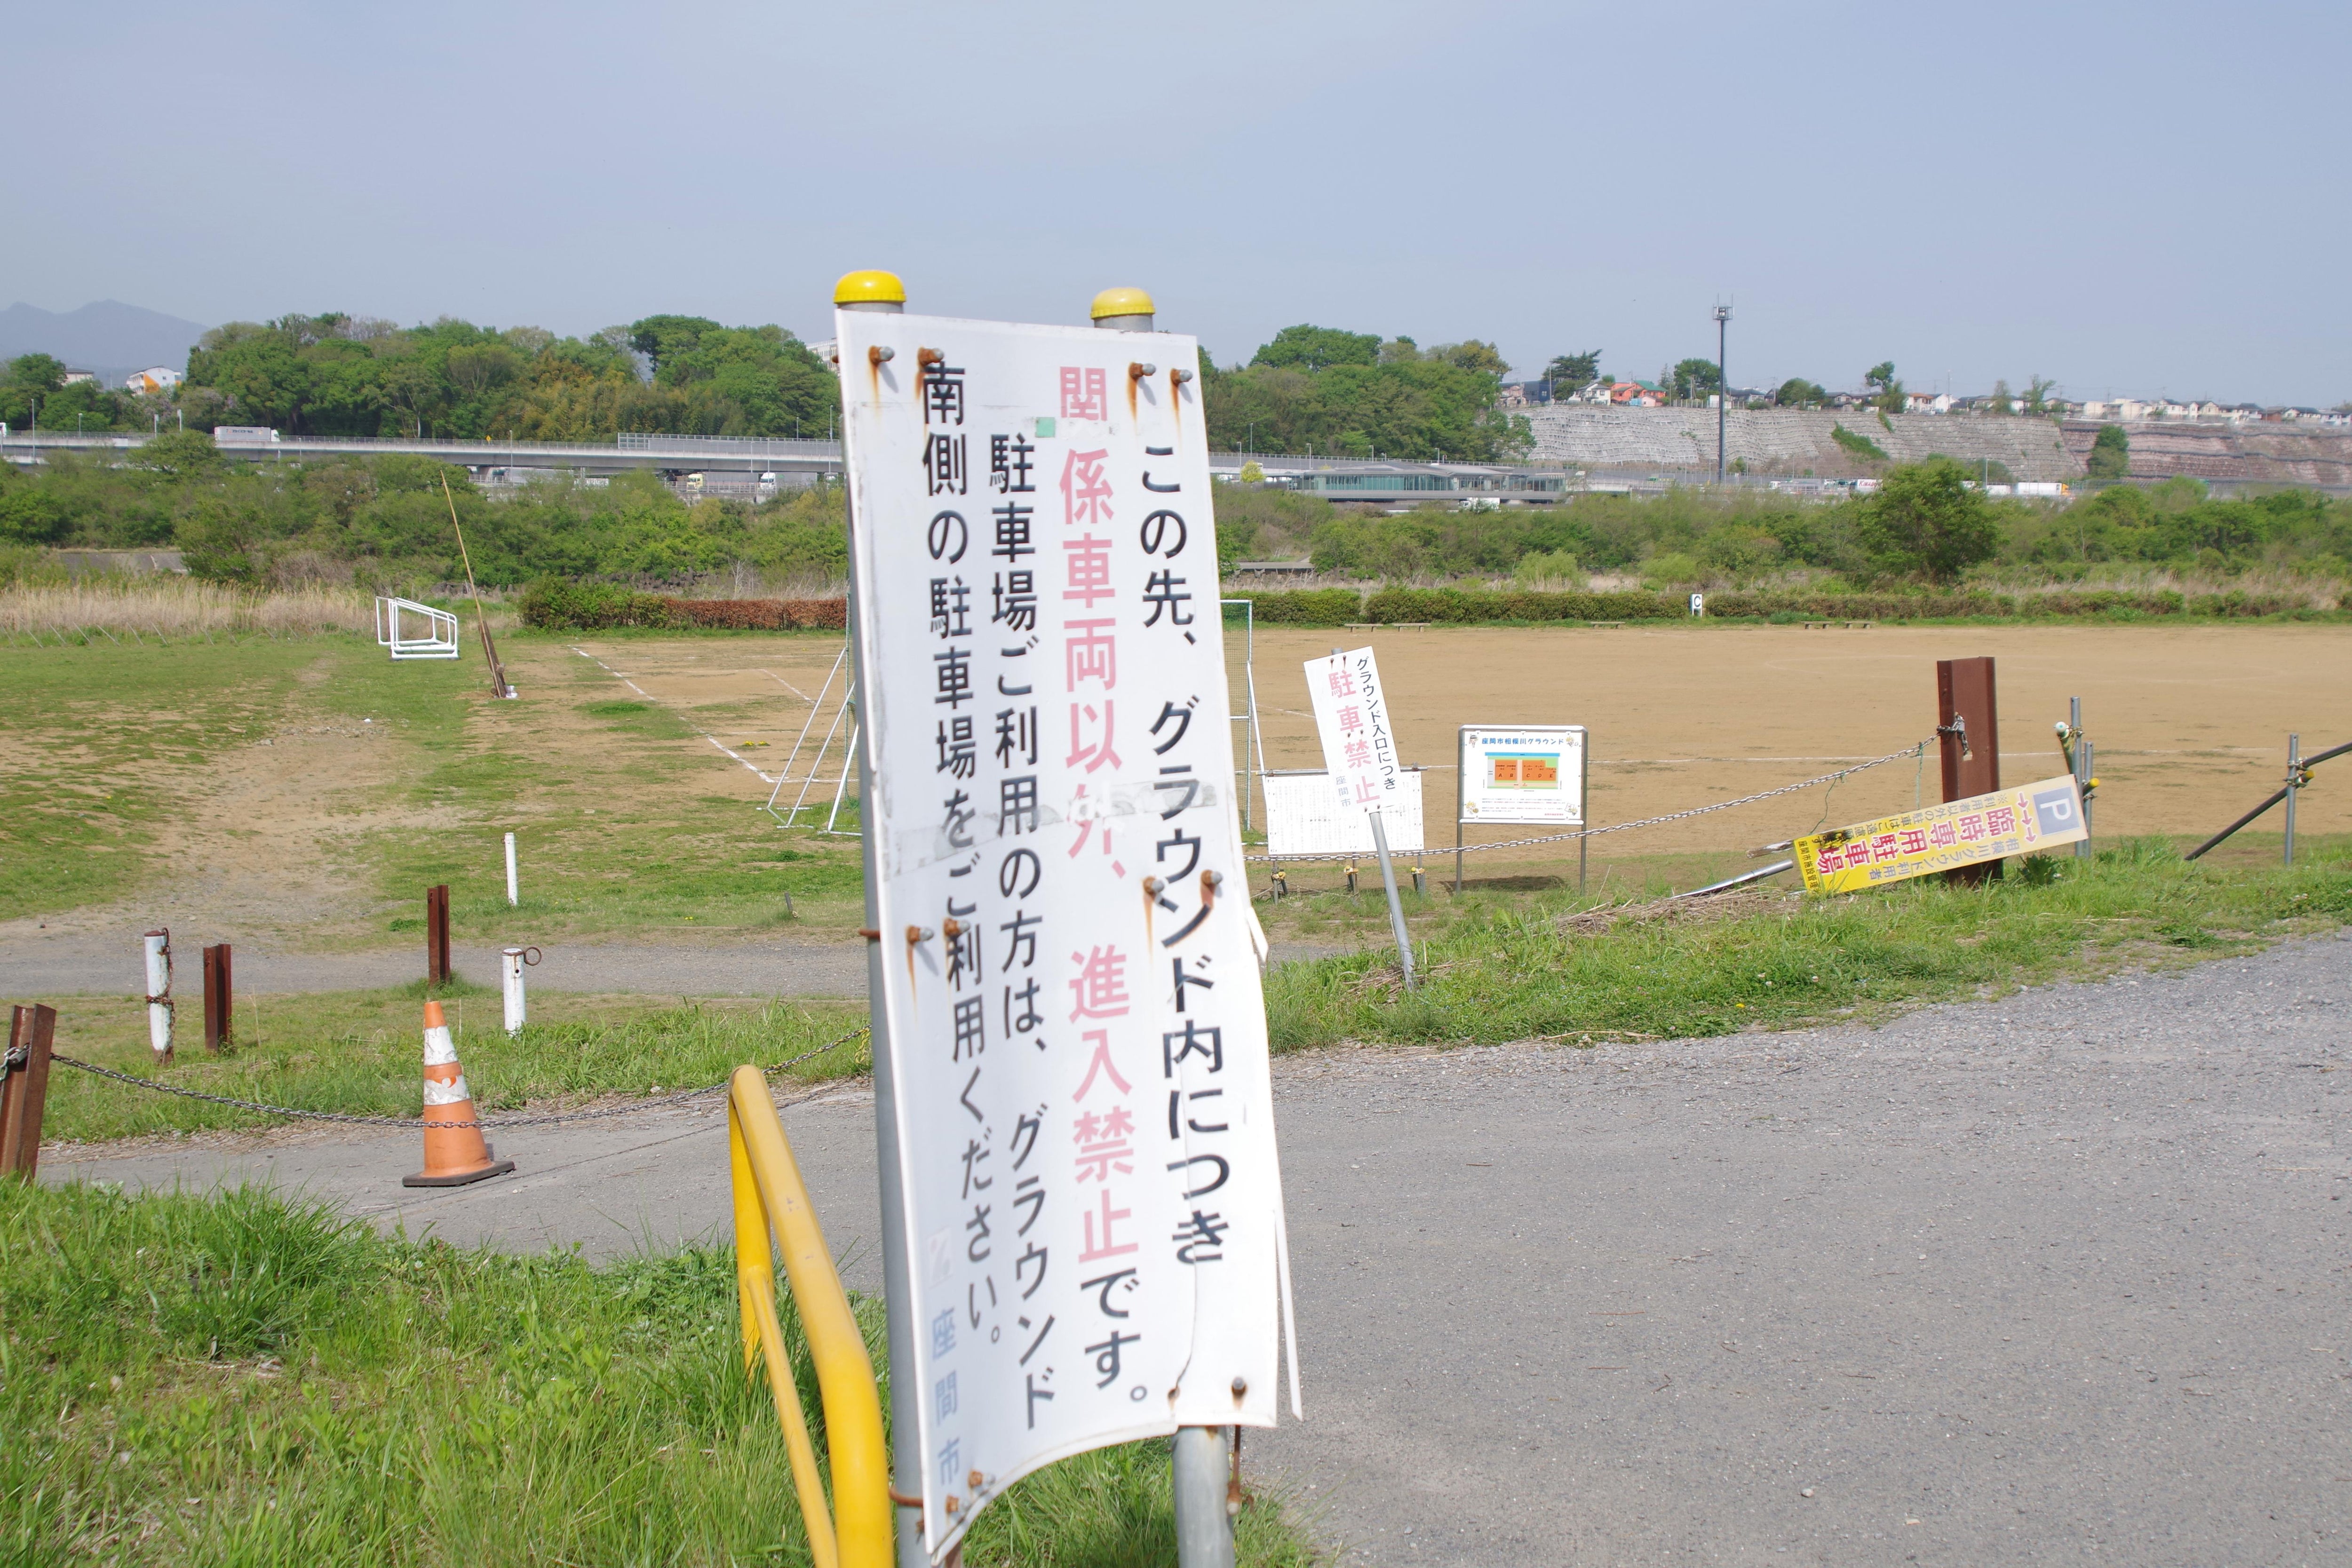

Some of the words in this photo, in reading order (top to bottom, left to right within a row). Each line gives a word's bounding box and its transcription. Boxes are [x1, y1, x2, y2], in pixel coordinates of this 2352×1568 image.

[1693, 595, 1701, 607] C
[1328, 669, 1381, 804] 駐車禁止
[1357, 656, 1396, 790] グラウンド入口につき
[1335, 775, 1351, 807] 座間市
[1817, 805, 2017, 874] 臨時専用駐車場
[2039, 797, 2071, 820] P
[921, 360, 1001, 1344] 南側の駐車場をご利用ください。
[1140, 446, 1232, 1265] この先、グラウンド内につき
[1798, 840, 1821, 891] 座間市施設管理
[1869, 837, 2020, 880] 相模川グラウンド利用者
[989, 433, 1055, 1430] 駐車場ご利用の方は、グラウンド
[931, 1307, 961, 1485] 座間市
